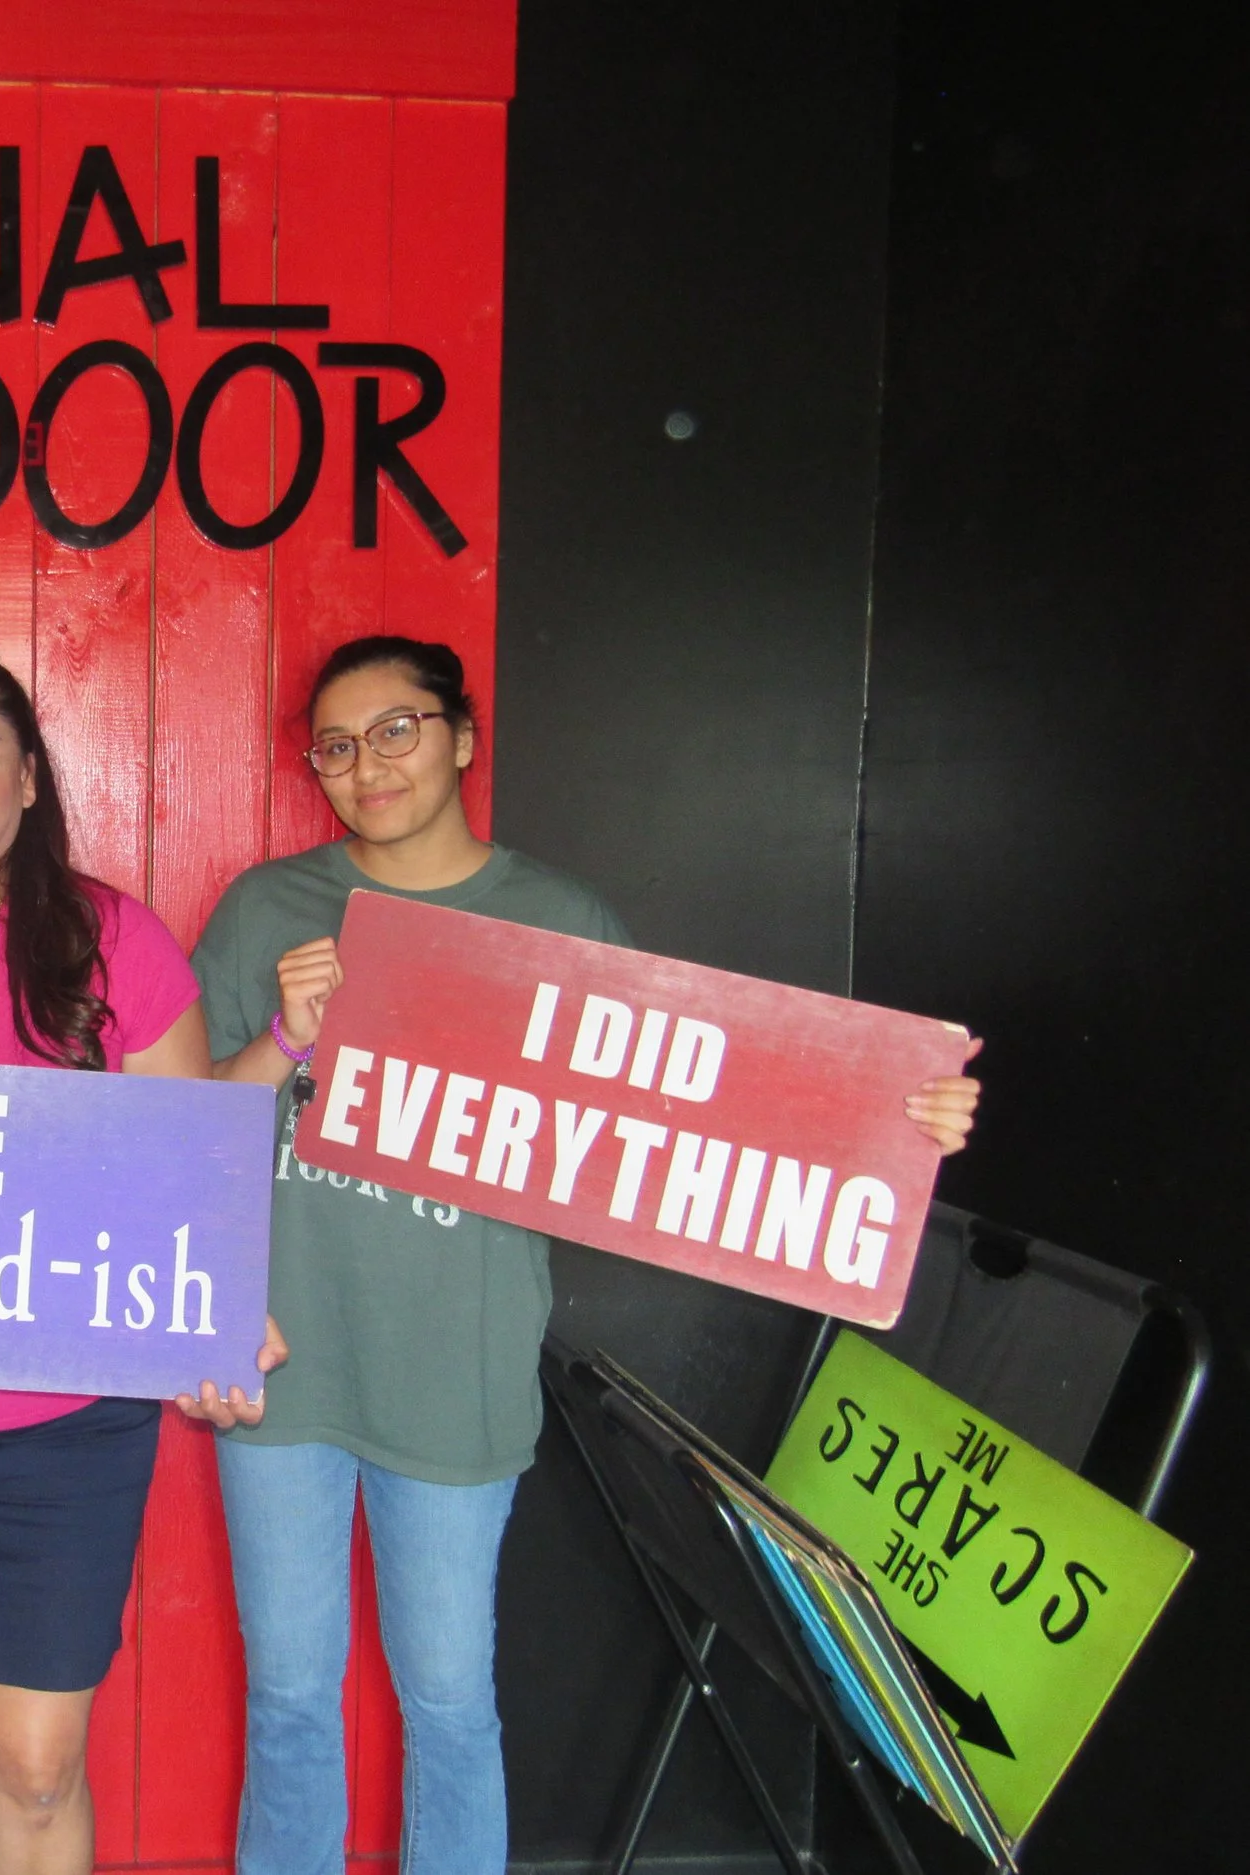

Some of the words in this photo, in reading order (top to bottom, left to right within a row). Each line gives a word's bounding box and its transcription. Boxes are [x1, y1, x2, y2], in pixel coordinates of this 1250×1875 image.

[520, 982, 560, 1062] I
[568, 993, 727, 1103] DID
[319, 1045, 897, 1290] EVERYTHING
[944, 1417, 1011, 1487] ME
[818, 1397, 1109, 1645] SCARES
[873, 1528, 949, 1608] SHE
